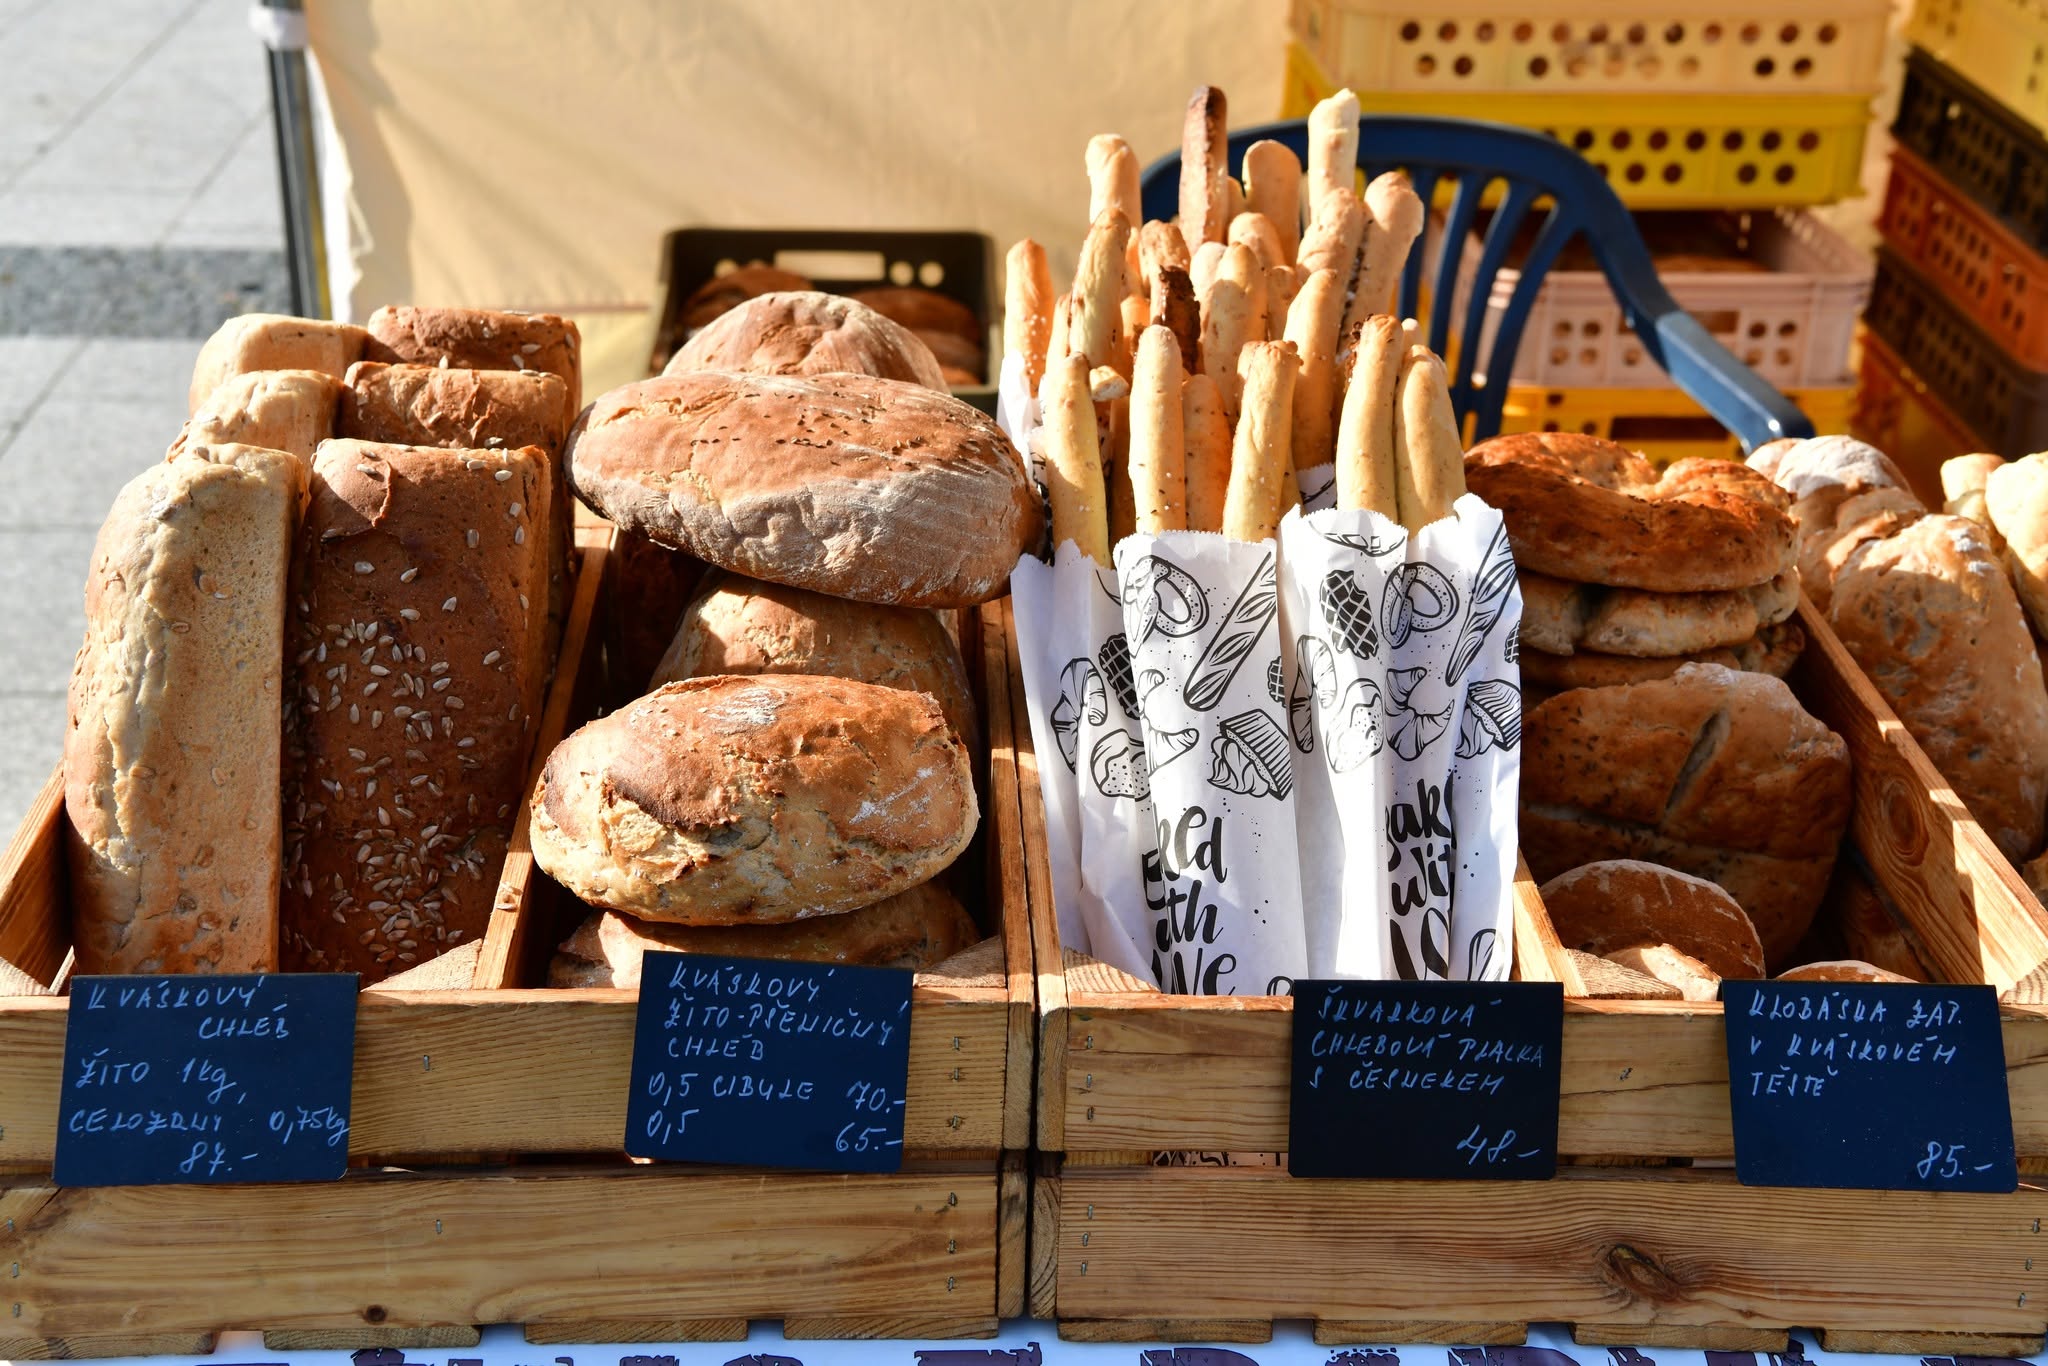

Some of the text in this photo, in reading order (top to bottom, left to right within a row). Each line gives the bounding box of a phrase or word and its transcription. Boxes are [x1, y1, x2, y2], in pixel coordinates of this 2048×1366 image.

[198, 1003, 289, 1040] CHLÉB
[1318, 985, 1503, 1027] ŠKVARKOVÁ
[667, 1033, 764, 1060] CHLÉB
[1311, 1029, 1545, 1069] CHLEBOVÁ PLACKA
[1750, 1034, 1763, 1056] V
[75, 1048, 150, 1089] ŽITO
[1309, 1060, 1505, 1096] S ČESNEKEM
[1750, 1064, 1839, 1097] TĚSTĚ
[648, 1071, 698, 1107] 0,5
[713, 1075, 813, 1101] CIBULE
[646, 1108, 700, 1145] 0,5
